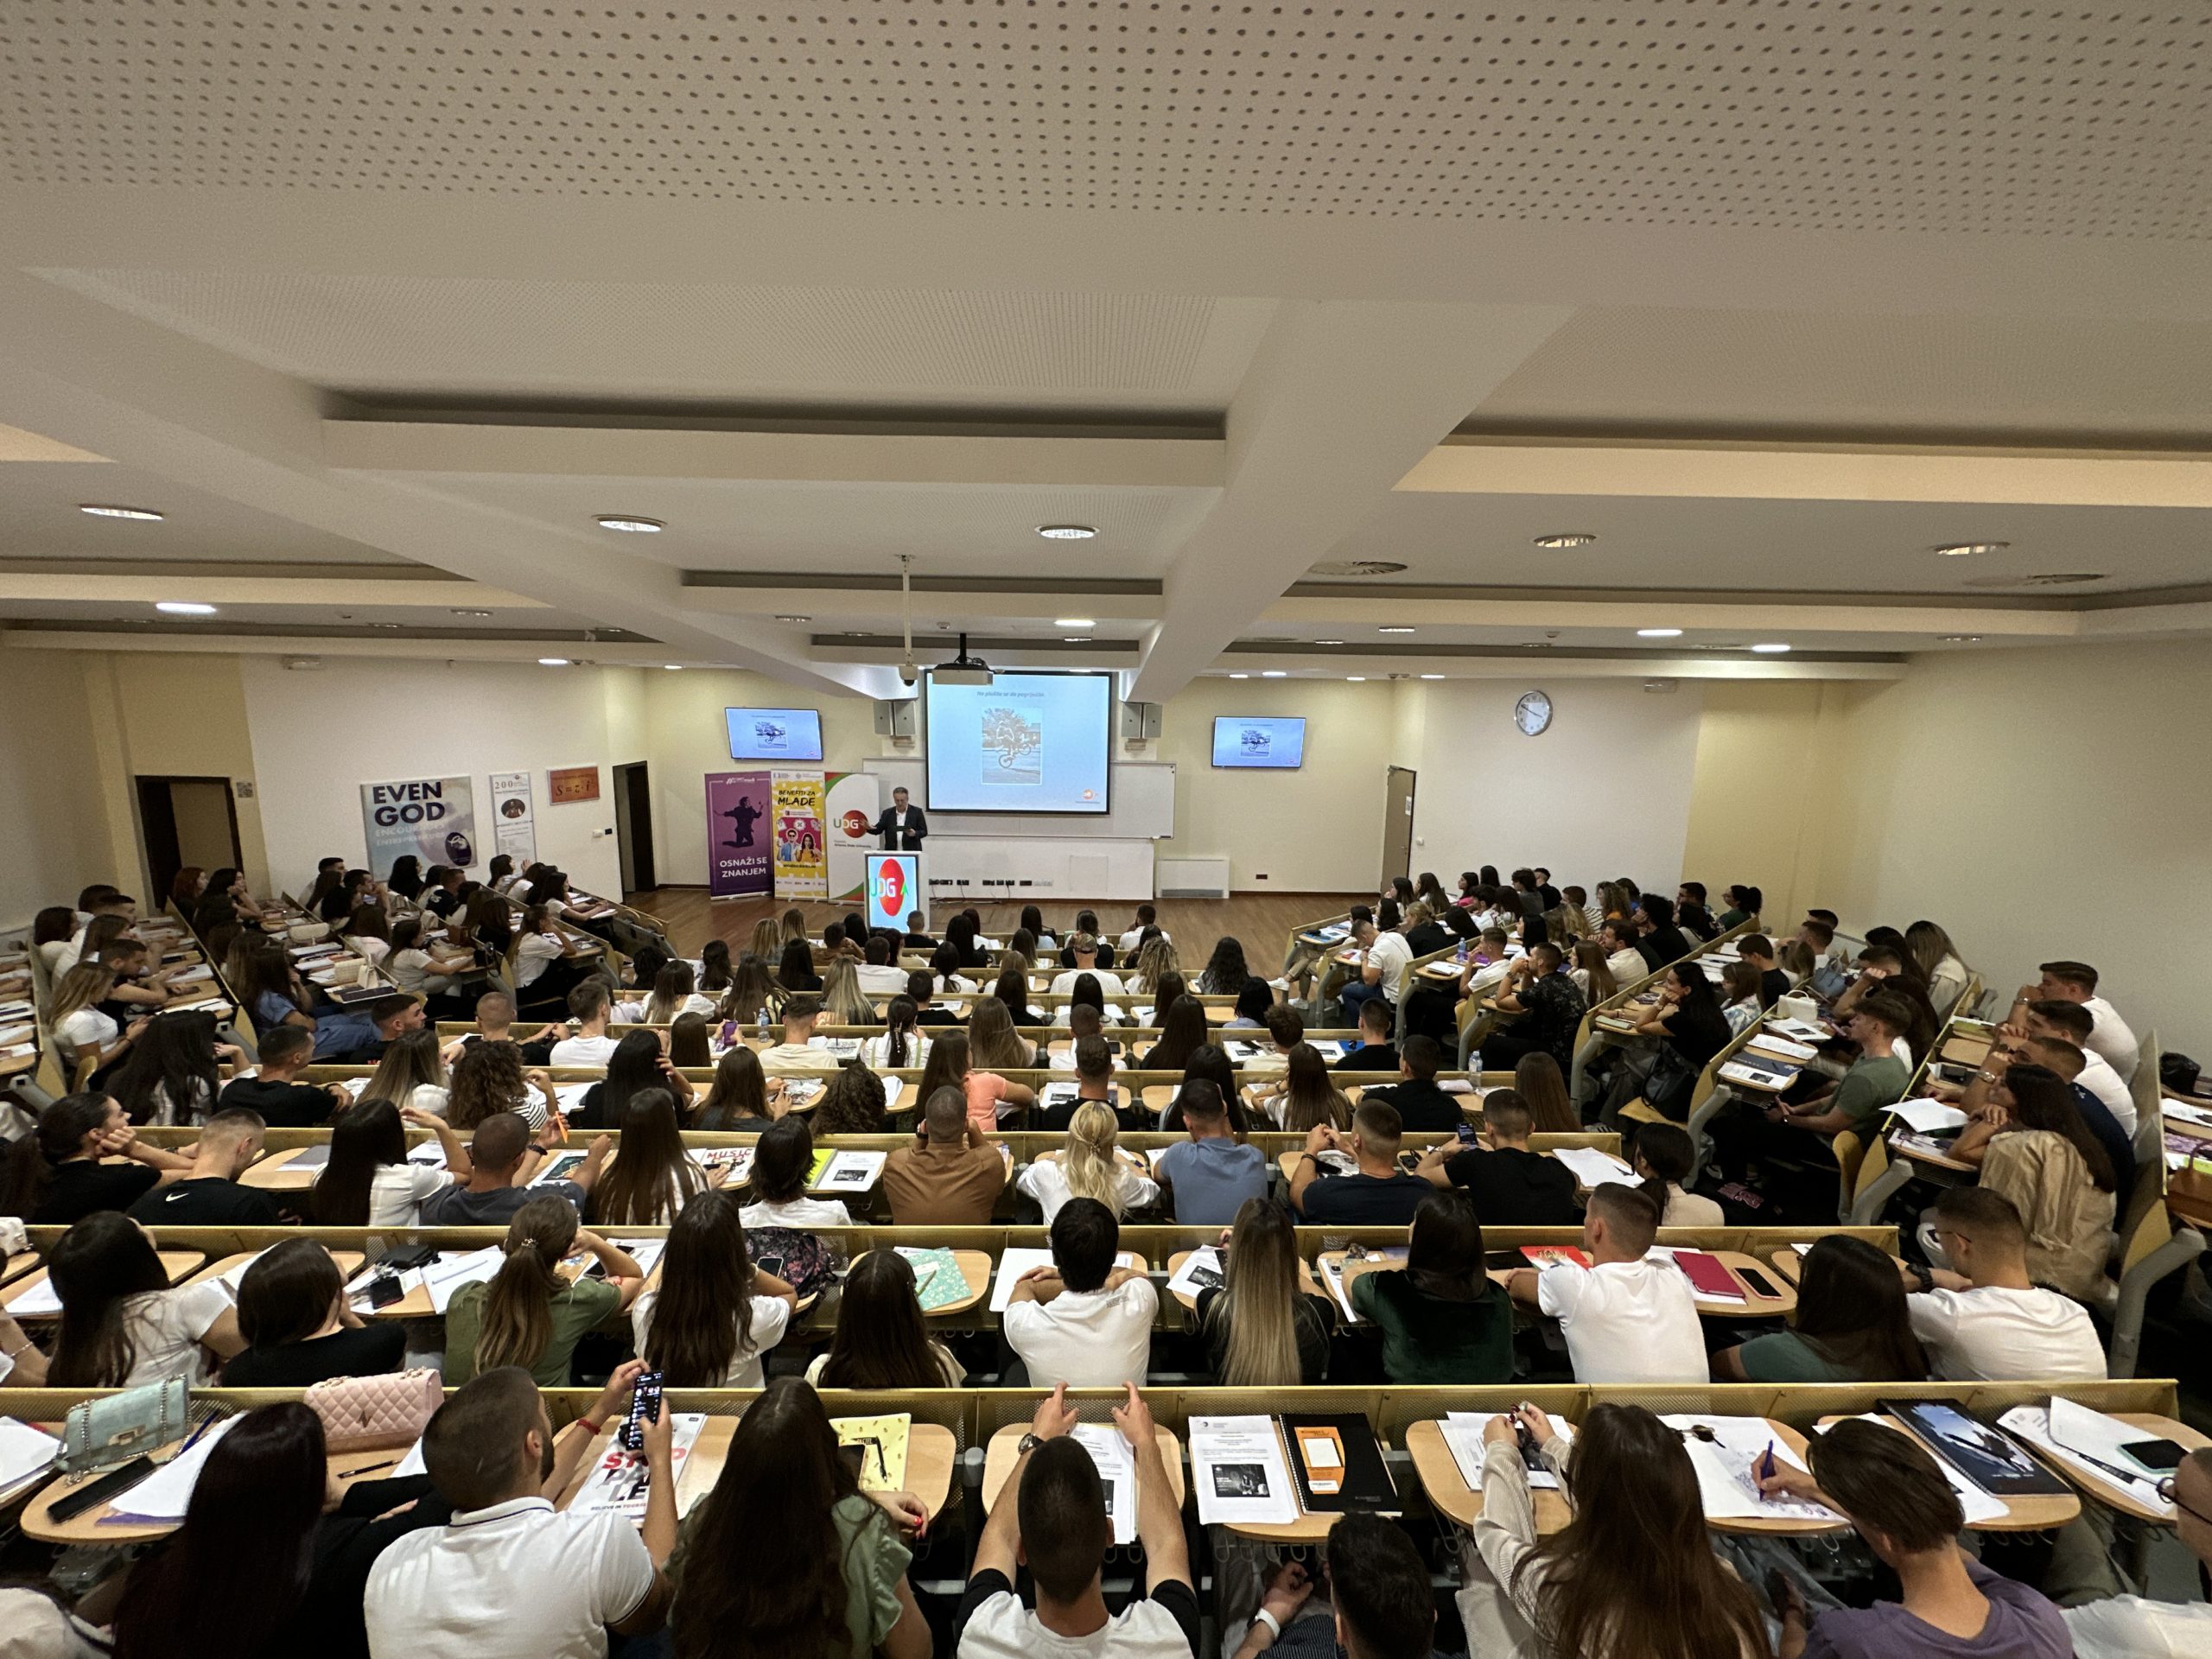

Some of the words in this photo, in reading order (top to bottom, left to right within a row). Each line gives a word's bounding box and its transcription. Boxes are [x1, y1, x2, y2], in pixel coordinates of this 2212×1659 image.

[373, 782, 442, 804] EVEN
[778, 797, 816, 807] MLADE
[374, 802, 445, 826] GOD
[719, 856, 755, 868] OSNAŽI
[721, 868, 766, 878] ZNANJEM
[707, 1148, 753, 1160] MUSIC
